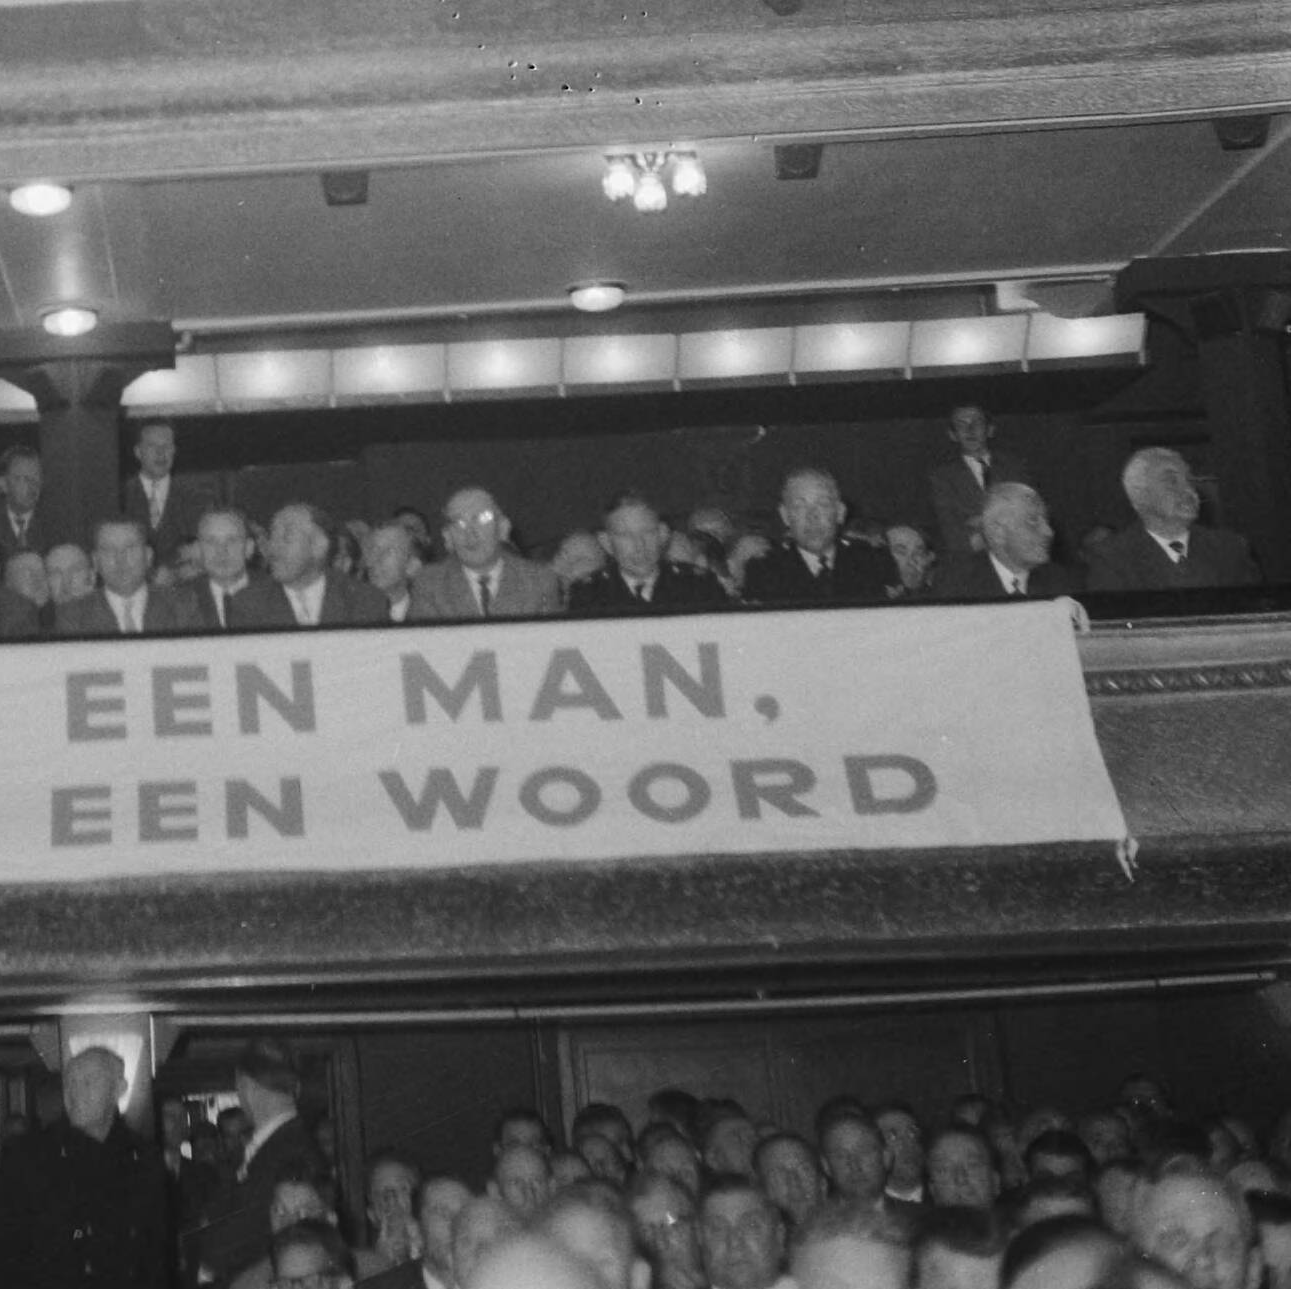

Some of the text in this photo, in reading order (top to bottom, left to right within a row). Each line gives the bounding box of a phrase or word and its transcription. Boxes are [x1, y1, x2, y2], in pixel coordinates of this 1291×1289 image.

[65, 659, 318, 744] EEN
[398, 641, 781, 727] MAN,
[49, 776, 307, 848] EEN
[379, 751, 939, 832] WOORD
